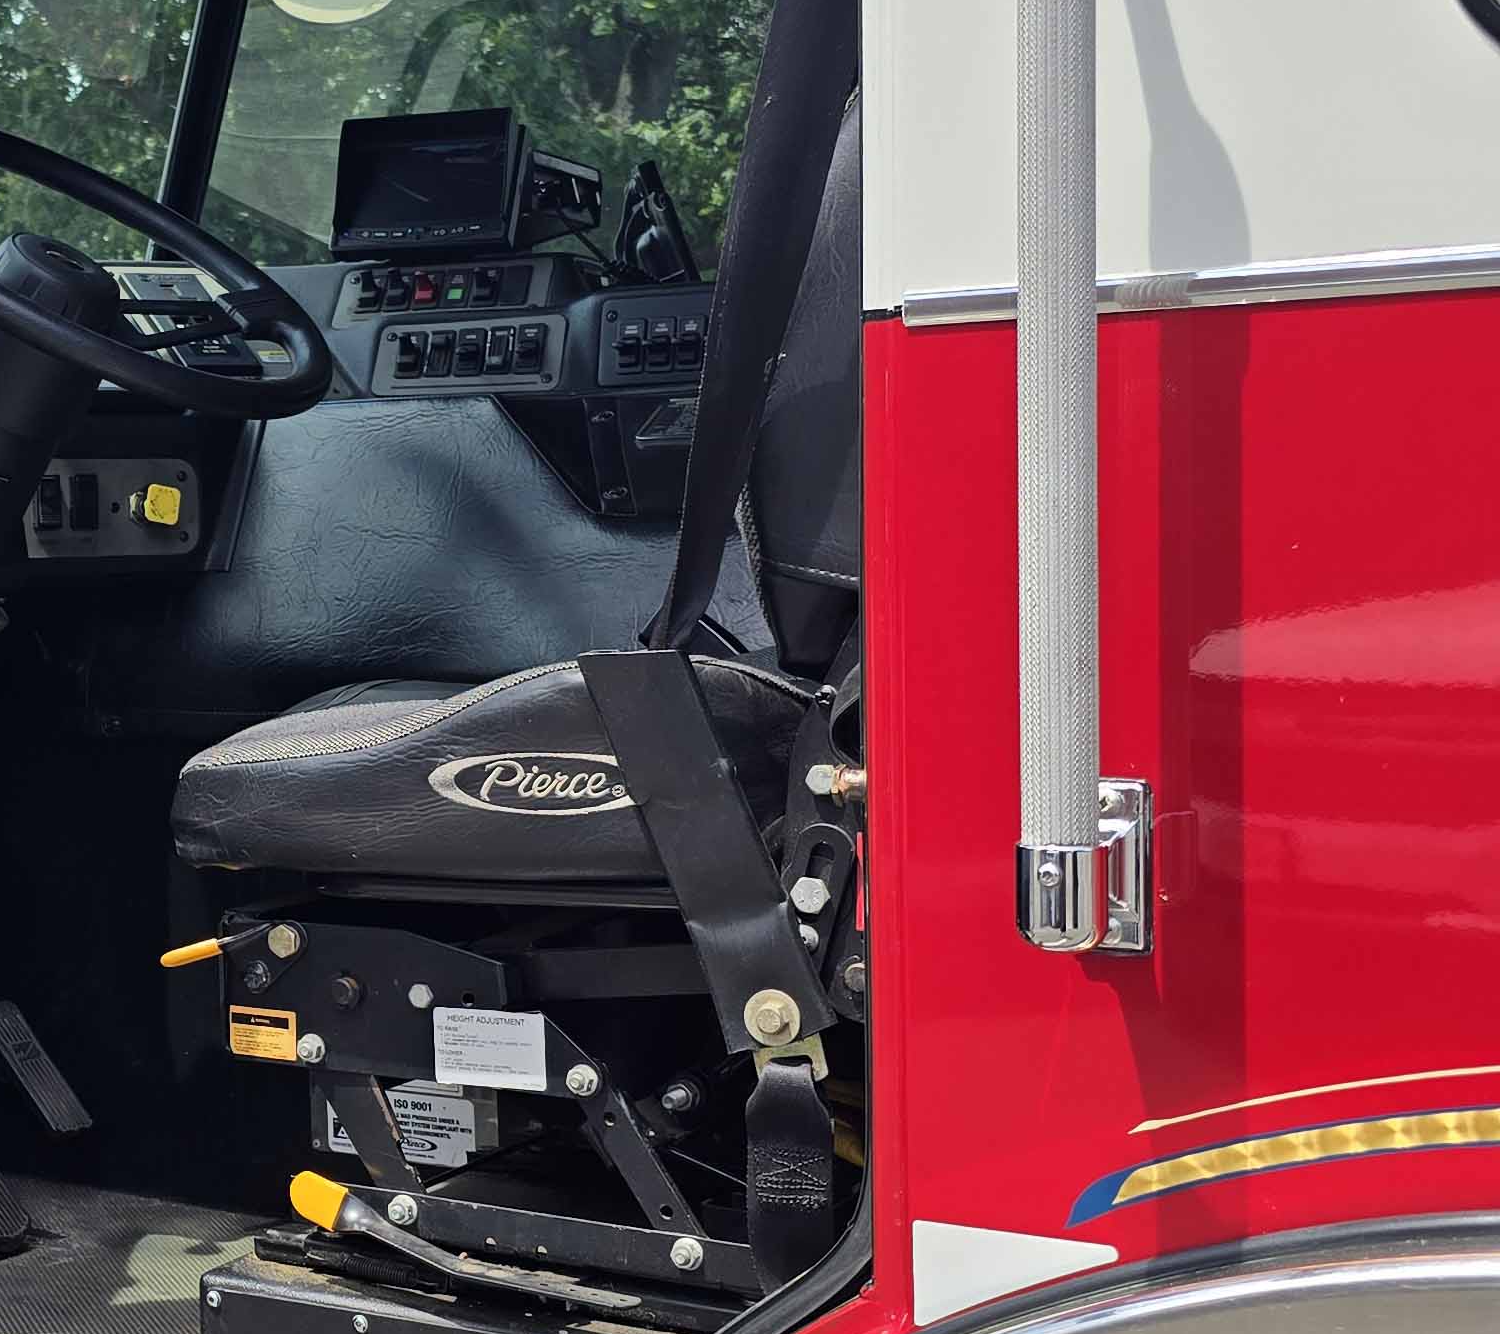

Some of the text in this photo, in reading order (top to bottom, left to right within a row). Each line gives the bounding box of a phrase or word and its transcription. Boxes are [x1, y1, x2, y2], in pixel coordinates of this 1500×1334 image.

[479, 760, 612, 802] Pierce
[447, 1014, 525, 1027] HEIGHT ADJUSTMENT
[393, 1099, 432, 1112] ISO 9001
